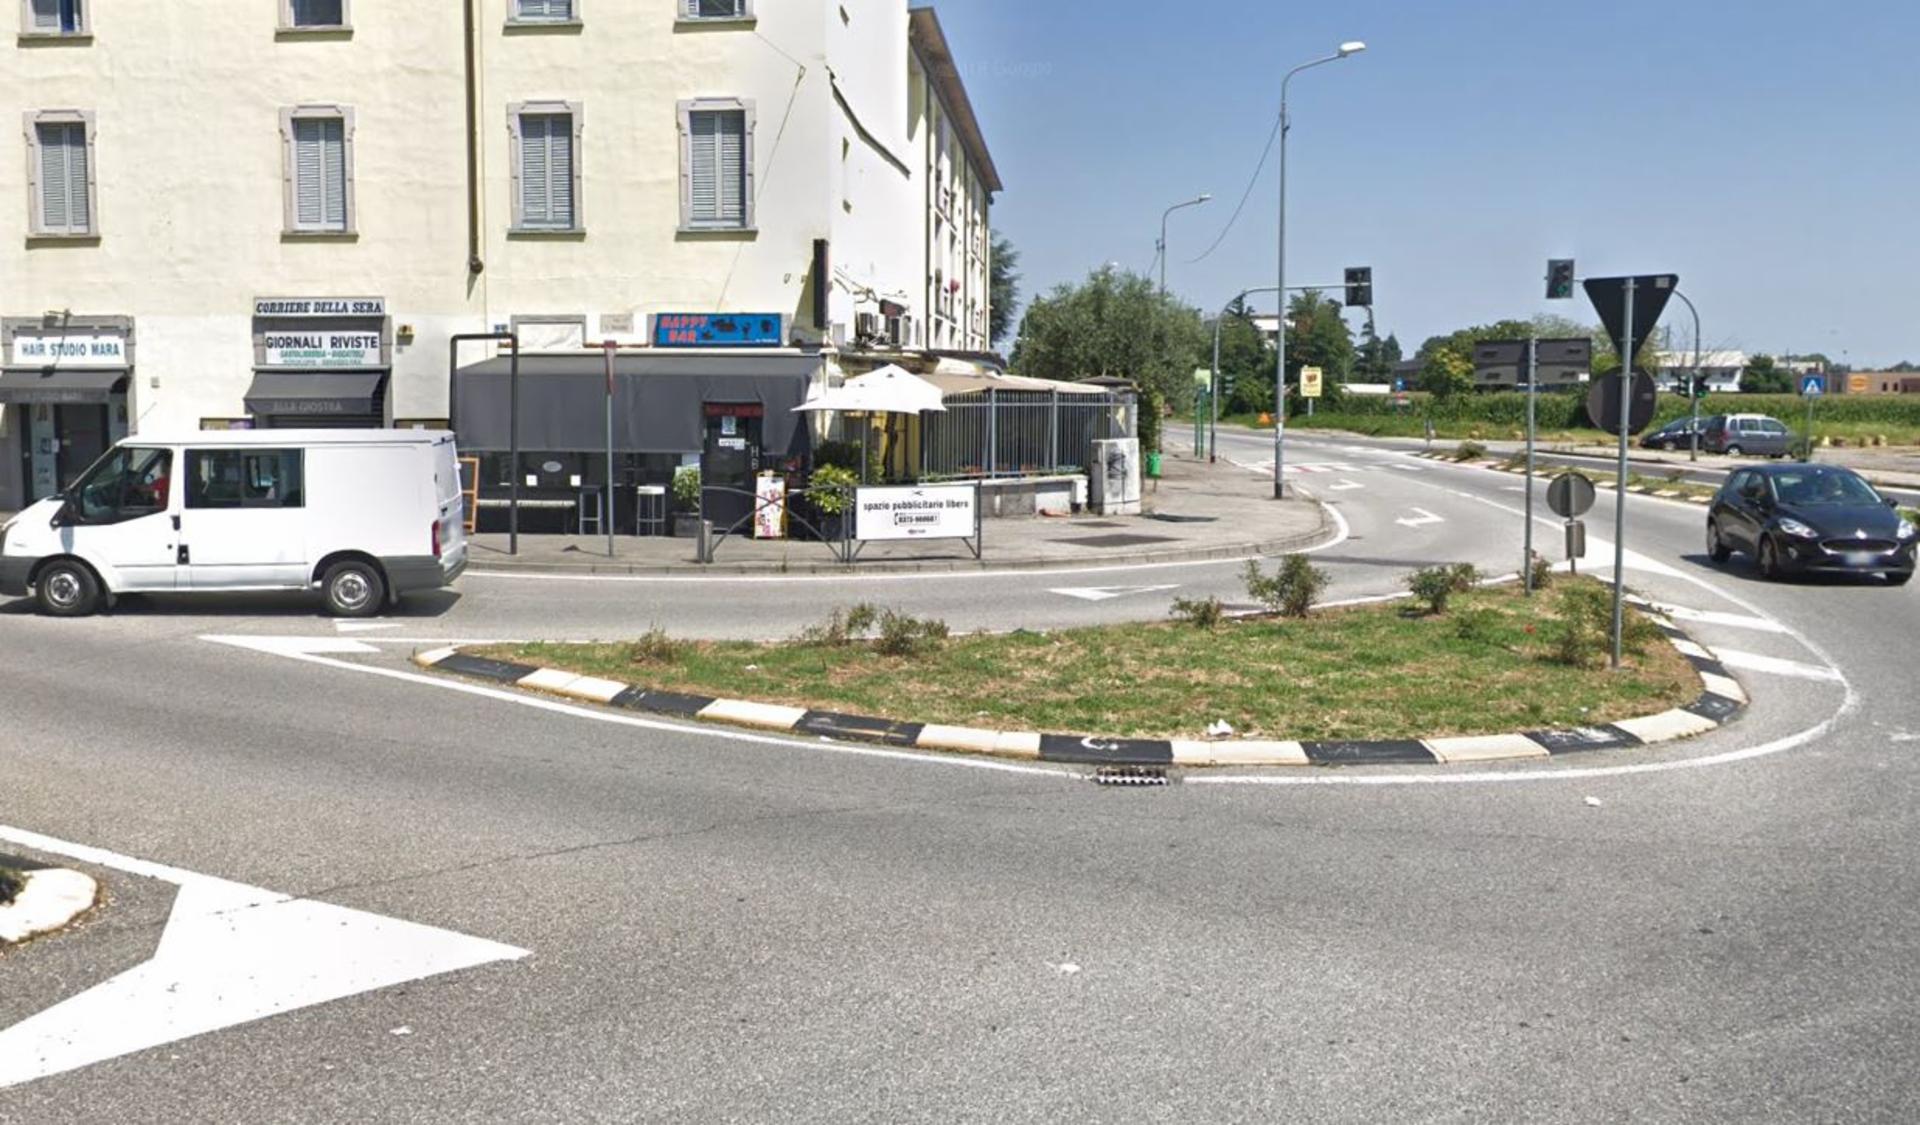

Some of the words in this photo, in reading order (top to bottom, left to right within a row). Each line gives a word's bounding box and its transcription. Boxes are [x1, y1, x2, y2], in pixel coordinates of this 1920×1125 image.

[256, 301, 311, 314] CORRIERE
[313, 301, 349, 314] DELLA
[352, 302, 382, 314] SERA
[660, 315, 708, 329] HAPPY
[266, 335, 323, 349] GIORNALI
[330, 335, 379, 349] RIVISTE
[668, 329, 696, 343] BAR
[22, 343, 46, 356] HAIR
[50, 342, 87, 357] STUDIO
[91, 342, 120, 356] MARA
[863, 502, 890, 512] spazio
[892, 499, 944, 511] pubblicitario
[945, 498, 969, 509] libero
